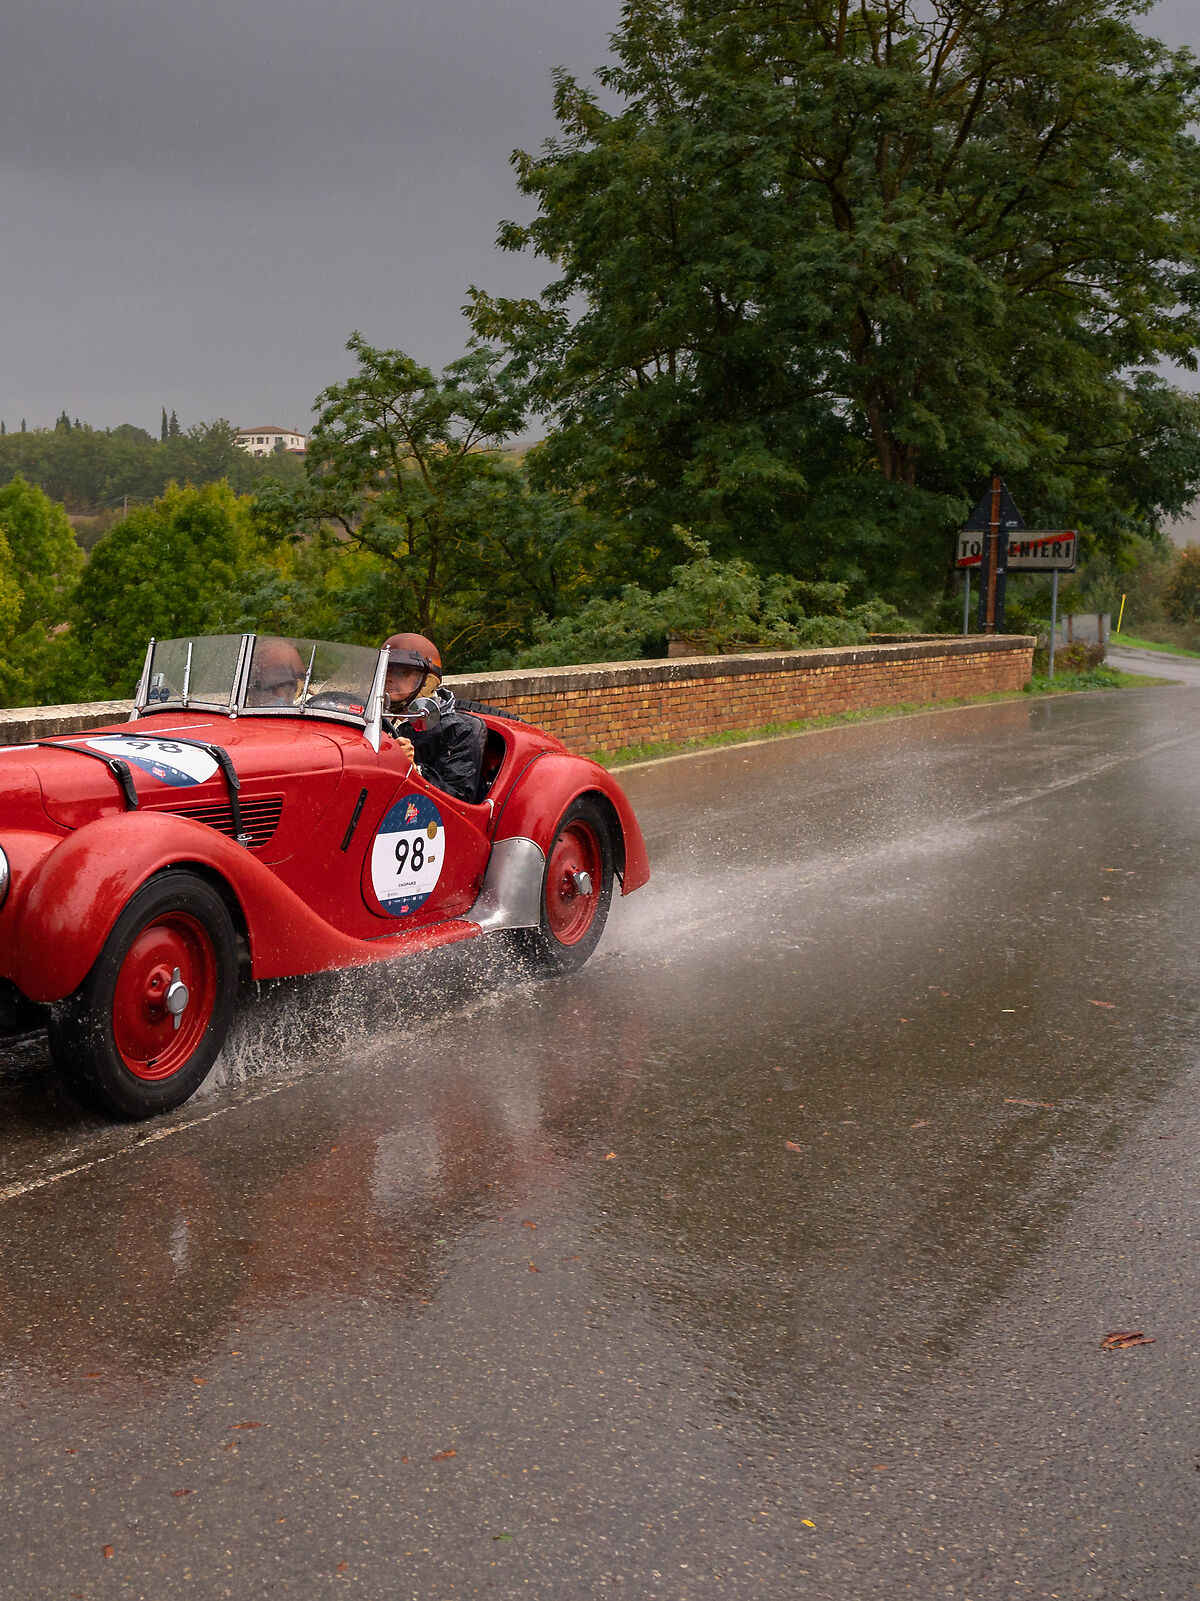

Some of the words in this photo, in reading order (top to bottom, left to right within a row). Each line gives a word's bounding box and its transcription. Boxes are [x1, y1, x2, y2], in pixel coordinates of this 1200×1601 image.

[960, 540, 1071, 558] TOENIERI
[126, 741, 183, 754] 98
[395, 836, 425, 875] 98
